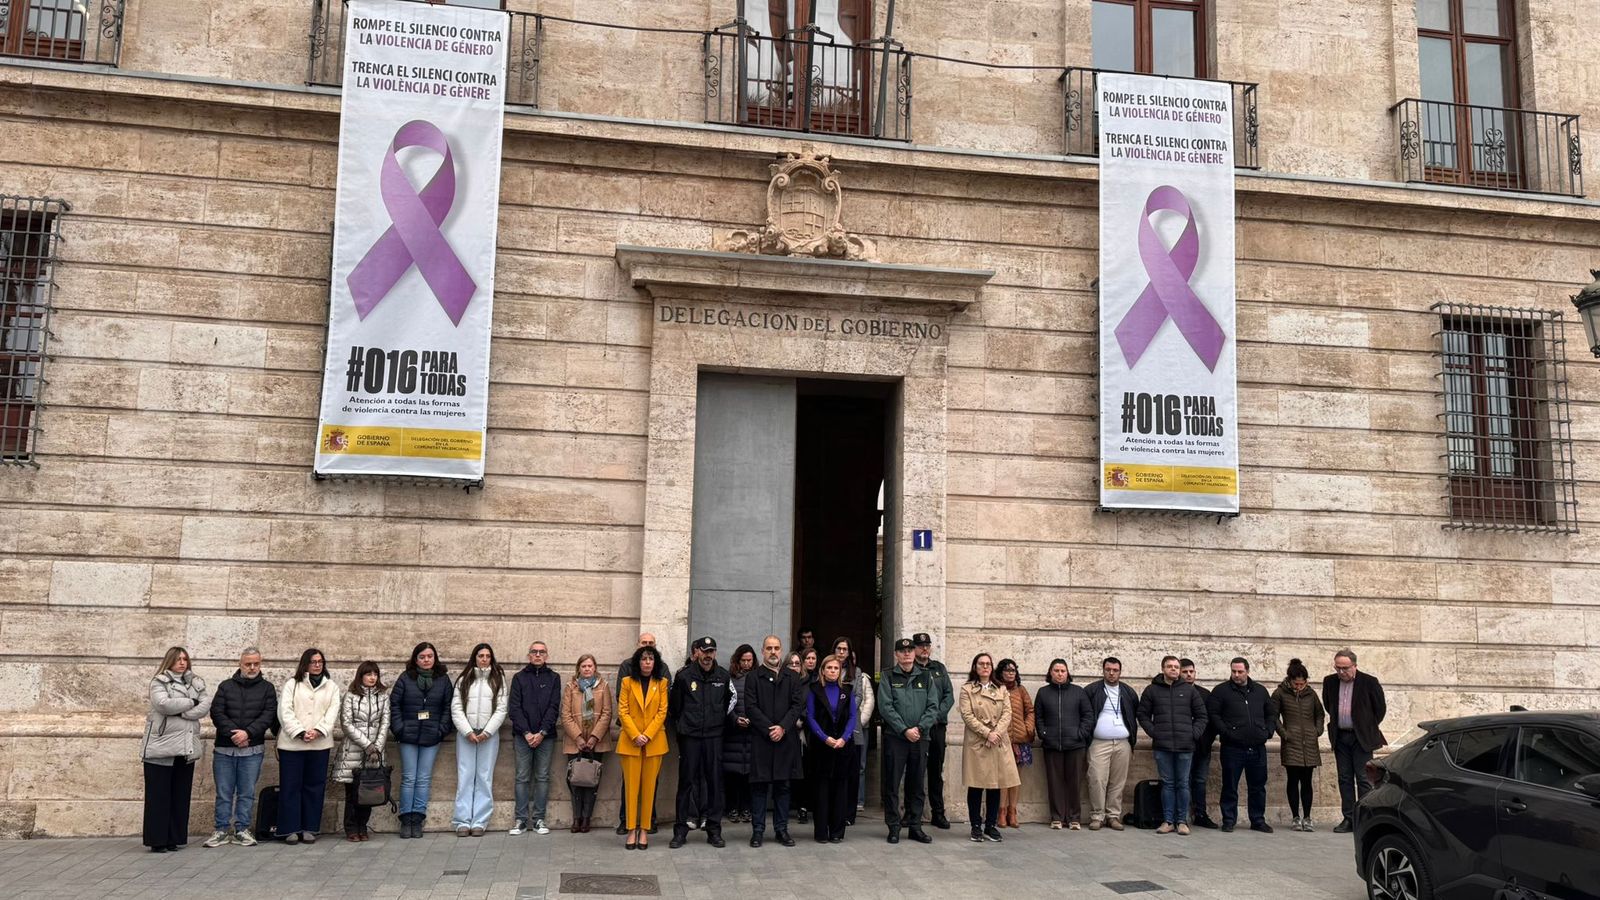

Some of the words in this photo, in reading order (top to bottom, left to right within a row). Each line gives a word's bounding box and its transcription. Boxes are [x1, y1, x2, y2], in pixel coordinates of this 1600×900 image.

[353, 18, 391, 32] ROMPE
[395, 22, 407, 33] EL
[409, 23, 457, 38] SILENCIO
[460, 28, 501, 42] CONTRA
[360, 33, 372, 45] LA
[376, 34, 432, 50] VIOLENCIA
[435, 40, 448, 51] DE
[451, 39, 493, 55] GÉNERO
[352, 62, 394, 76] TRENCA
[397, 66, 409, 77] EL
[412, 67, 452, 81] SILENCI
[456, 71, 496, 86] CONTRA
[357, 76, 370, 88] LA
[373, 78, 429, 94] VIOLÈNCIA
[433, 83, 446, 96] DE
[450, 84, 490, 100] GÈNERE
[1104, 92, 1135, 104] ROMPE
[1137, 95, 1147, 105] EL
[1150, 95, 1189, 108] SILENCIO
[1192, 98, 1227, 111] CONTRA
[1110, 106, 1120, 117] LA
[1122, 107, 1169, 120] VIOLENCIA
[1172, 111, 1183, 121] DE
[1186, 110, 1221, 124] GÉNERO
[1106, 133, 1141, 145] TRENCA
[1144, 135, 1154, 146] EL
[1156, 136, 1188, 149] SILENCI
[1192, 139, 1227, 151] CONTRA
[1112, 147, 1122, 157] LA
[1125, 146, 1171, 161] VIOLÈNCIA
[1175, 151, 1185, 162] DE
[1188, 150, 1223, 164] GÈNERE
[660, 306, 798, 331] DELEGACION
[803, 317, 835, 333] DEL
[841, 319, 941, 340] GOBIERNO
[346, 346, 418, 394] #016
[421, 351, 457, 373] PARA
[421, 372, 466, 396] TODAS
[432, 399, 460, 407] formas
[1121, 392, 1182, 435] #016
[1184, 396, 1216, 416] PARA
[1185, 416, 1223, 437] TODAS
[918, 532, 925, 547] 1
